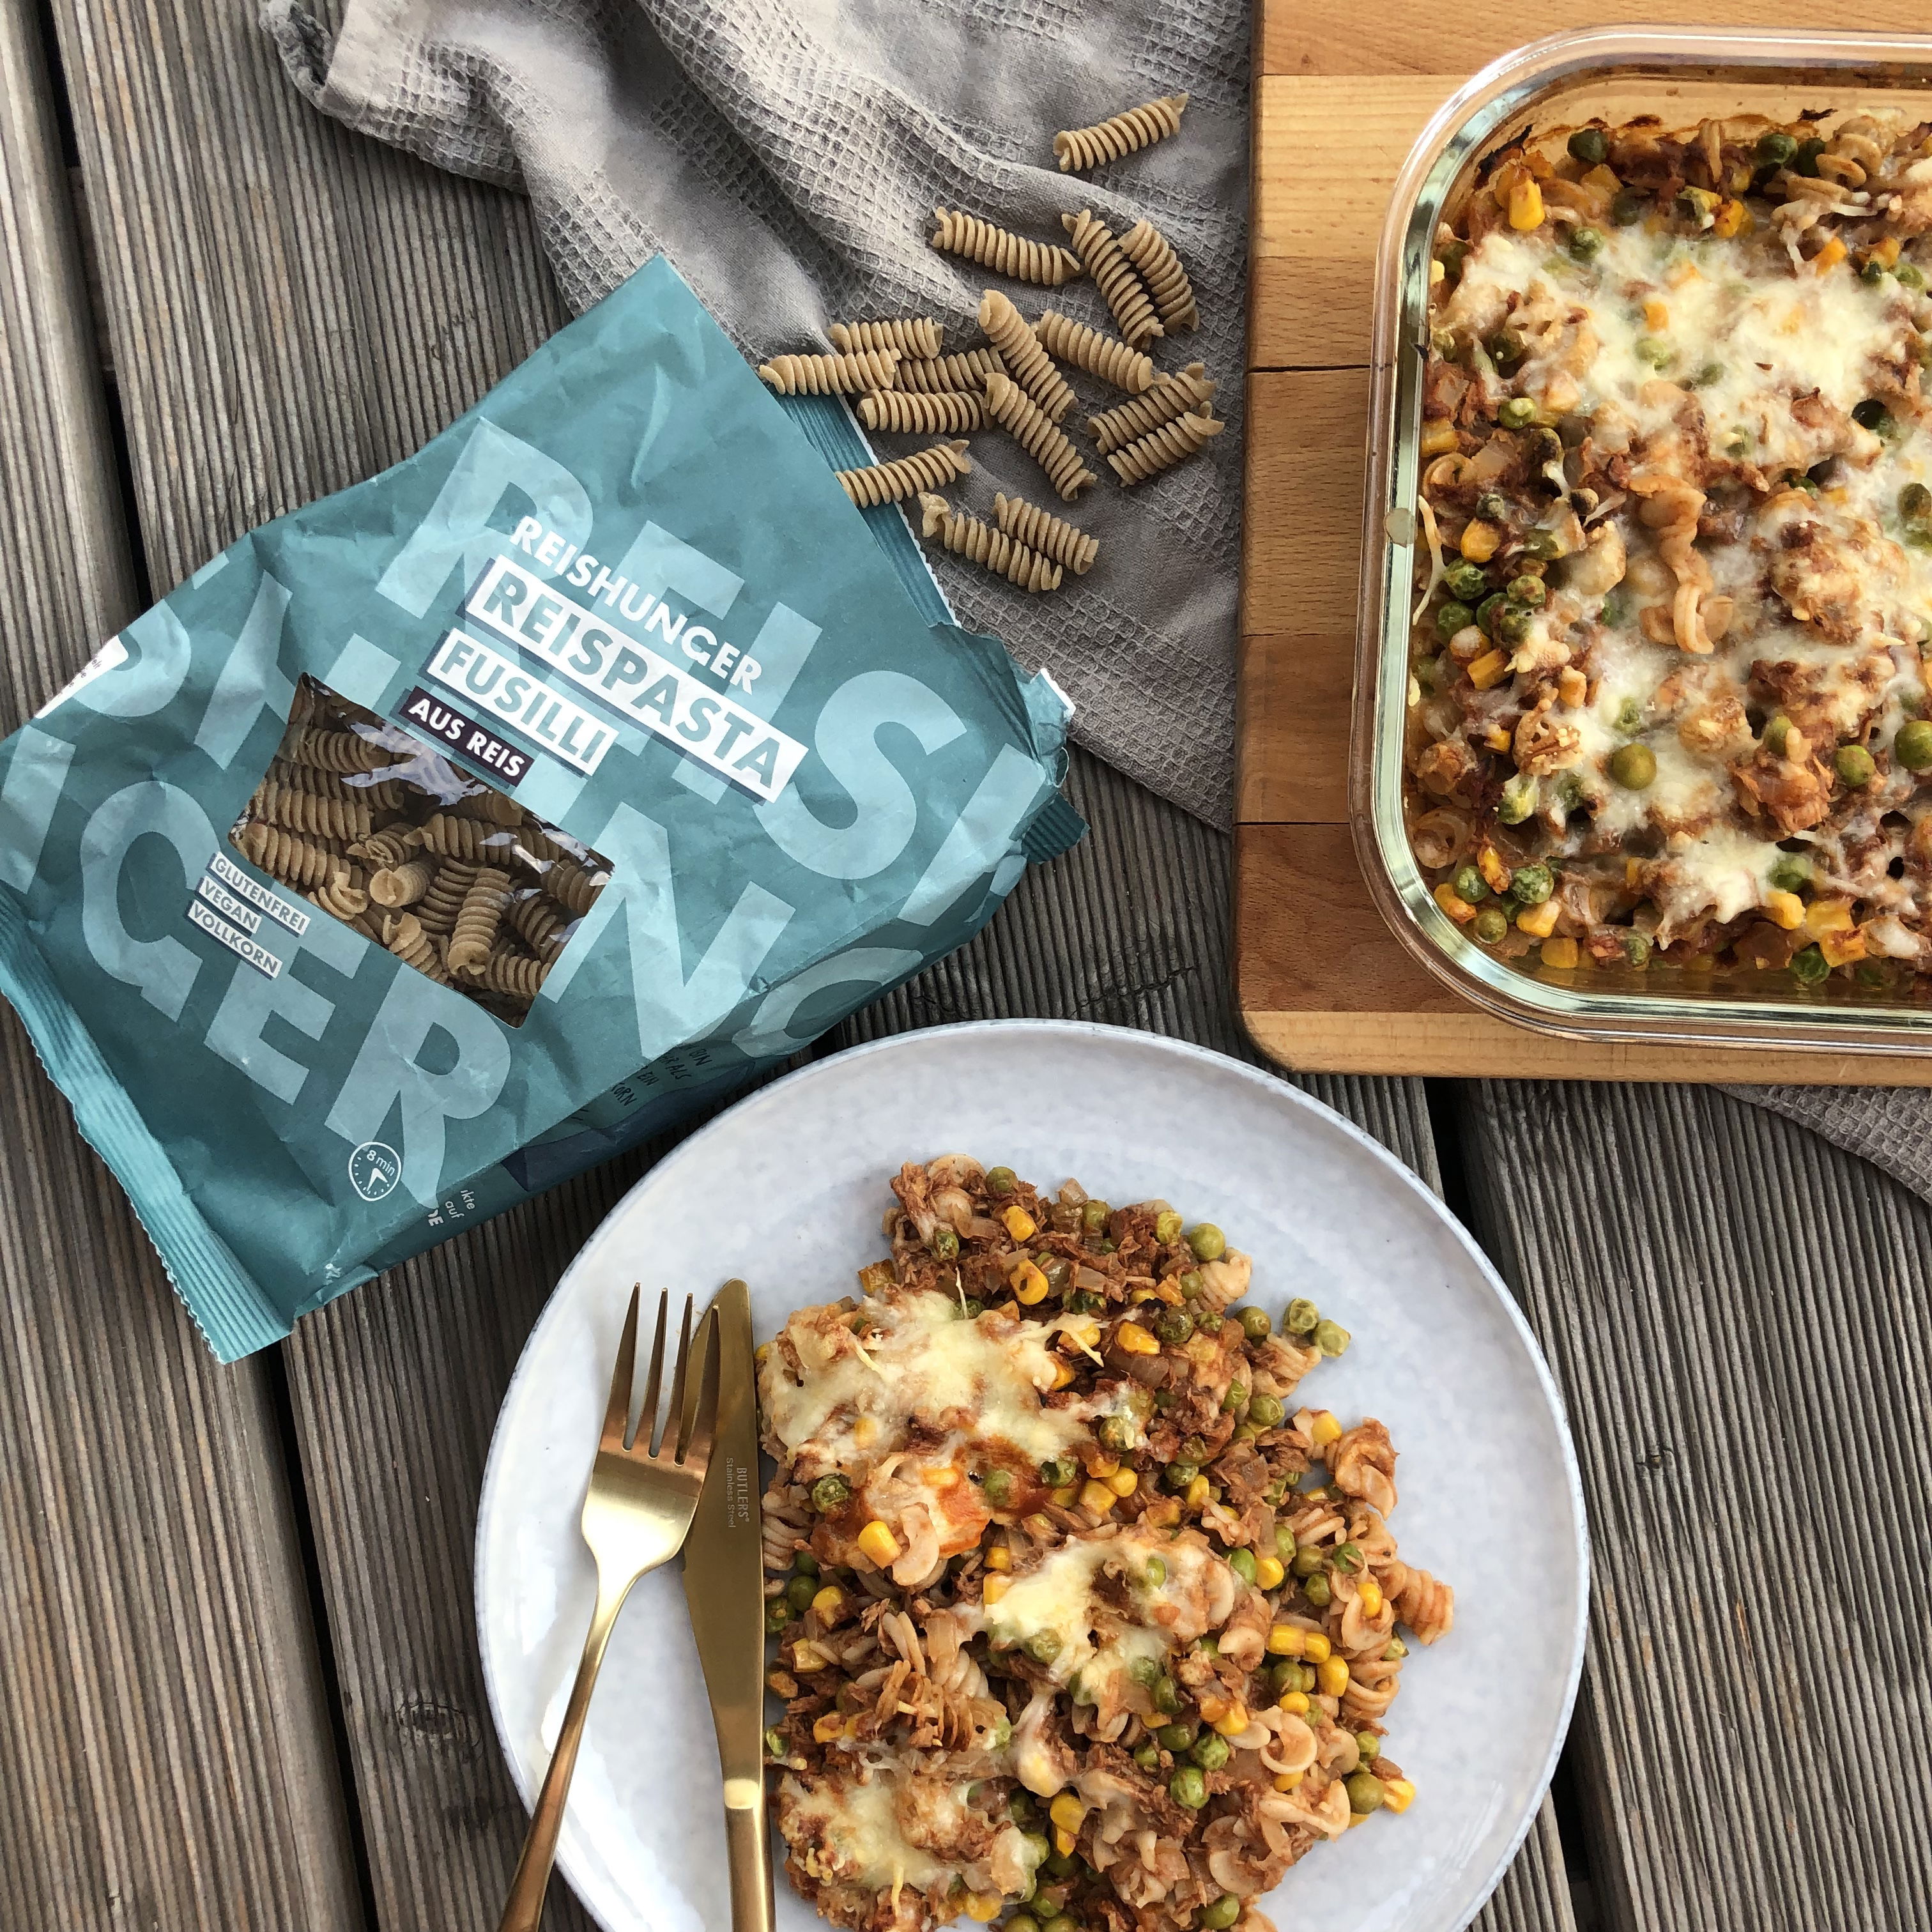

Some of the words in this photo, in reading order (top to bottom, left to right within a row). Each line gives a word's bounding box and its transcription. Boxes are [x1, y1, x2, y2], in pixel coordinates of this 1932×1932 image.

[509, 515, 763, 696] REISHUNGER
[441, 640, 604, 764] FUSILLI
[482, 571, 782, 790] REISPASTA
[408, 698, 466, 740] AUS
[466, 730, 526, 778] REIS
[204, 880, 258, 929] VEGAN
[215, 858, 306, 931] GLUTENFREI
[193, 903, 279, 974] VOLLKORN
[636, 1071, 659, 1086] EIN
[366, 1149, 377, 1162] 8
[376, 1158, 395, 1177] min
[445, 1200, 465, 1219] auf
[726, 1457, 735, 1501] Stainless
[728, 1504, 736, 1528] Steel
